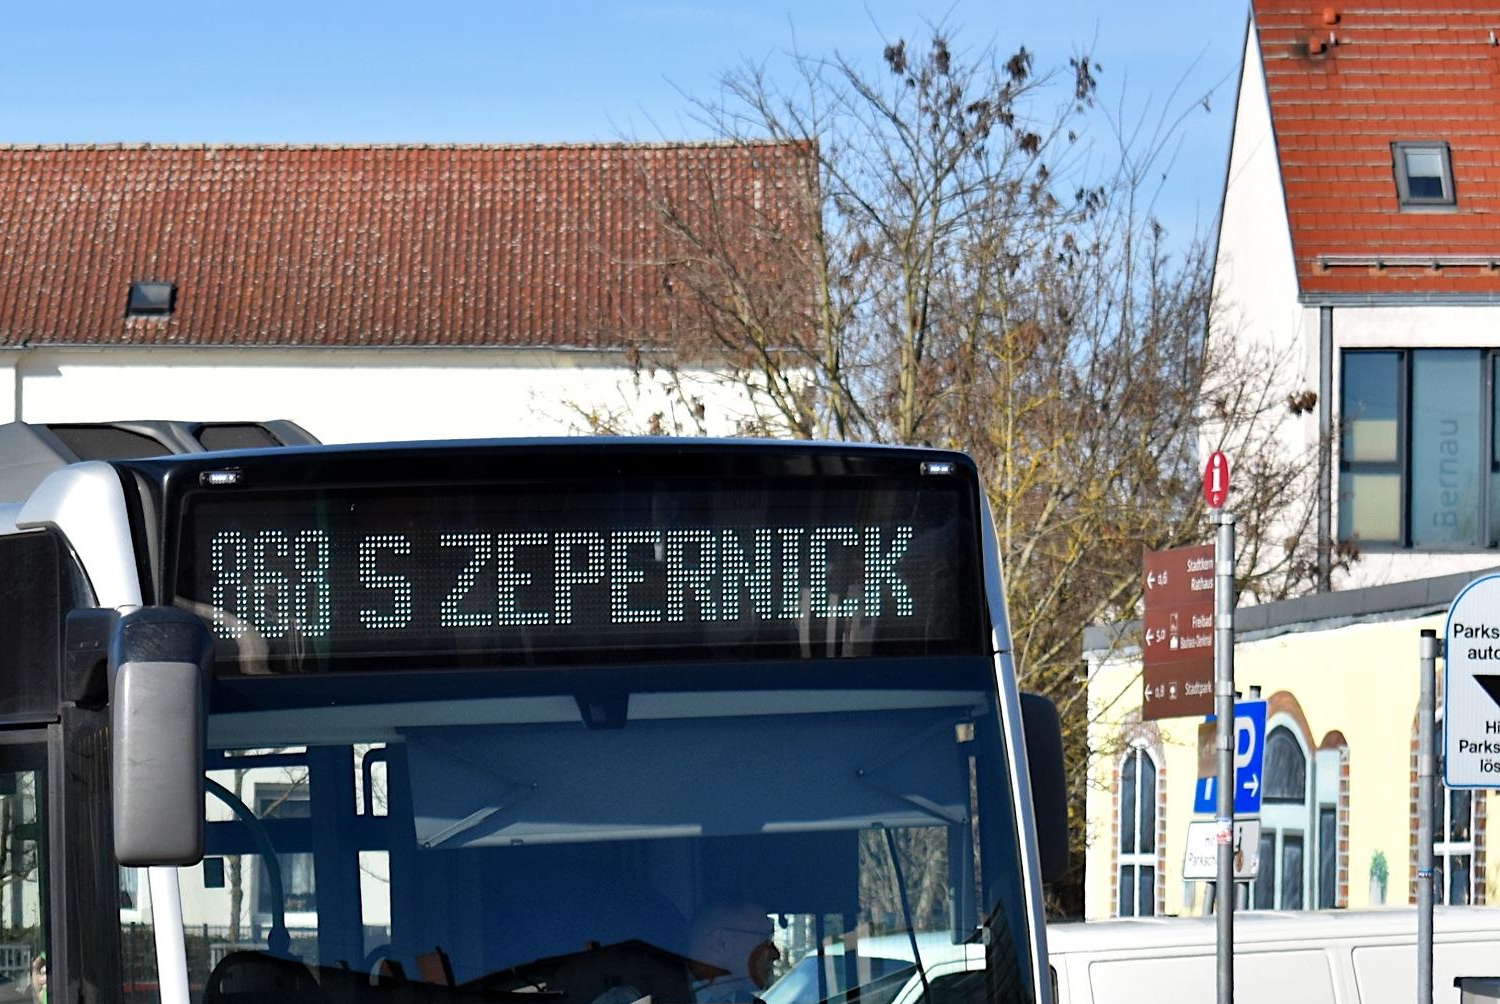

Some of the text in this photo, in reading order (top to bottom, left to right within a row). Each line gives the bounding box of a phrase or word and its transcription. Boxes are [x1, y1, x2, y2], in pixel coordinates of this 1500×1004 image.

[210, 525, 914, 638] 868 S ZEPERNICK
[1185, 681, 1212, 697] Stadtpark
